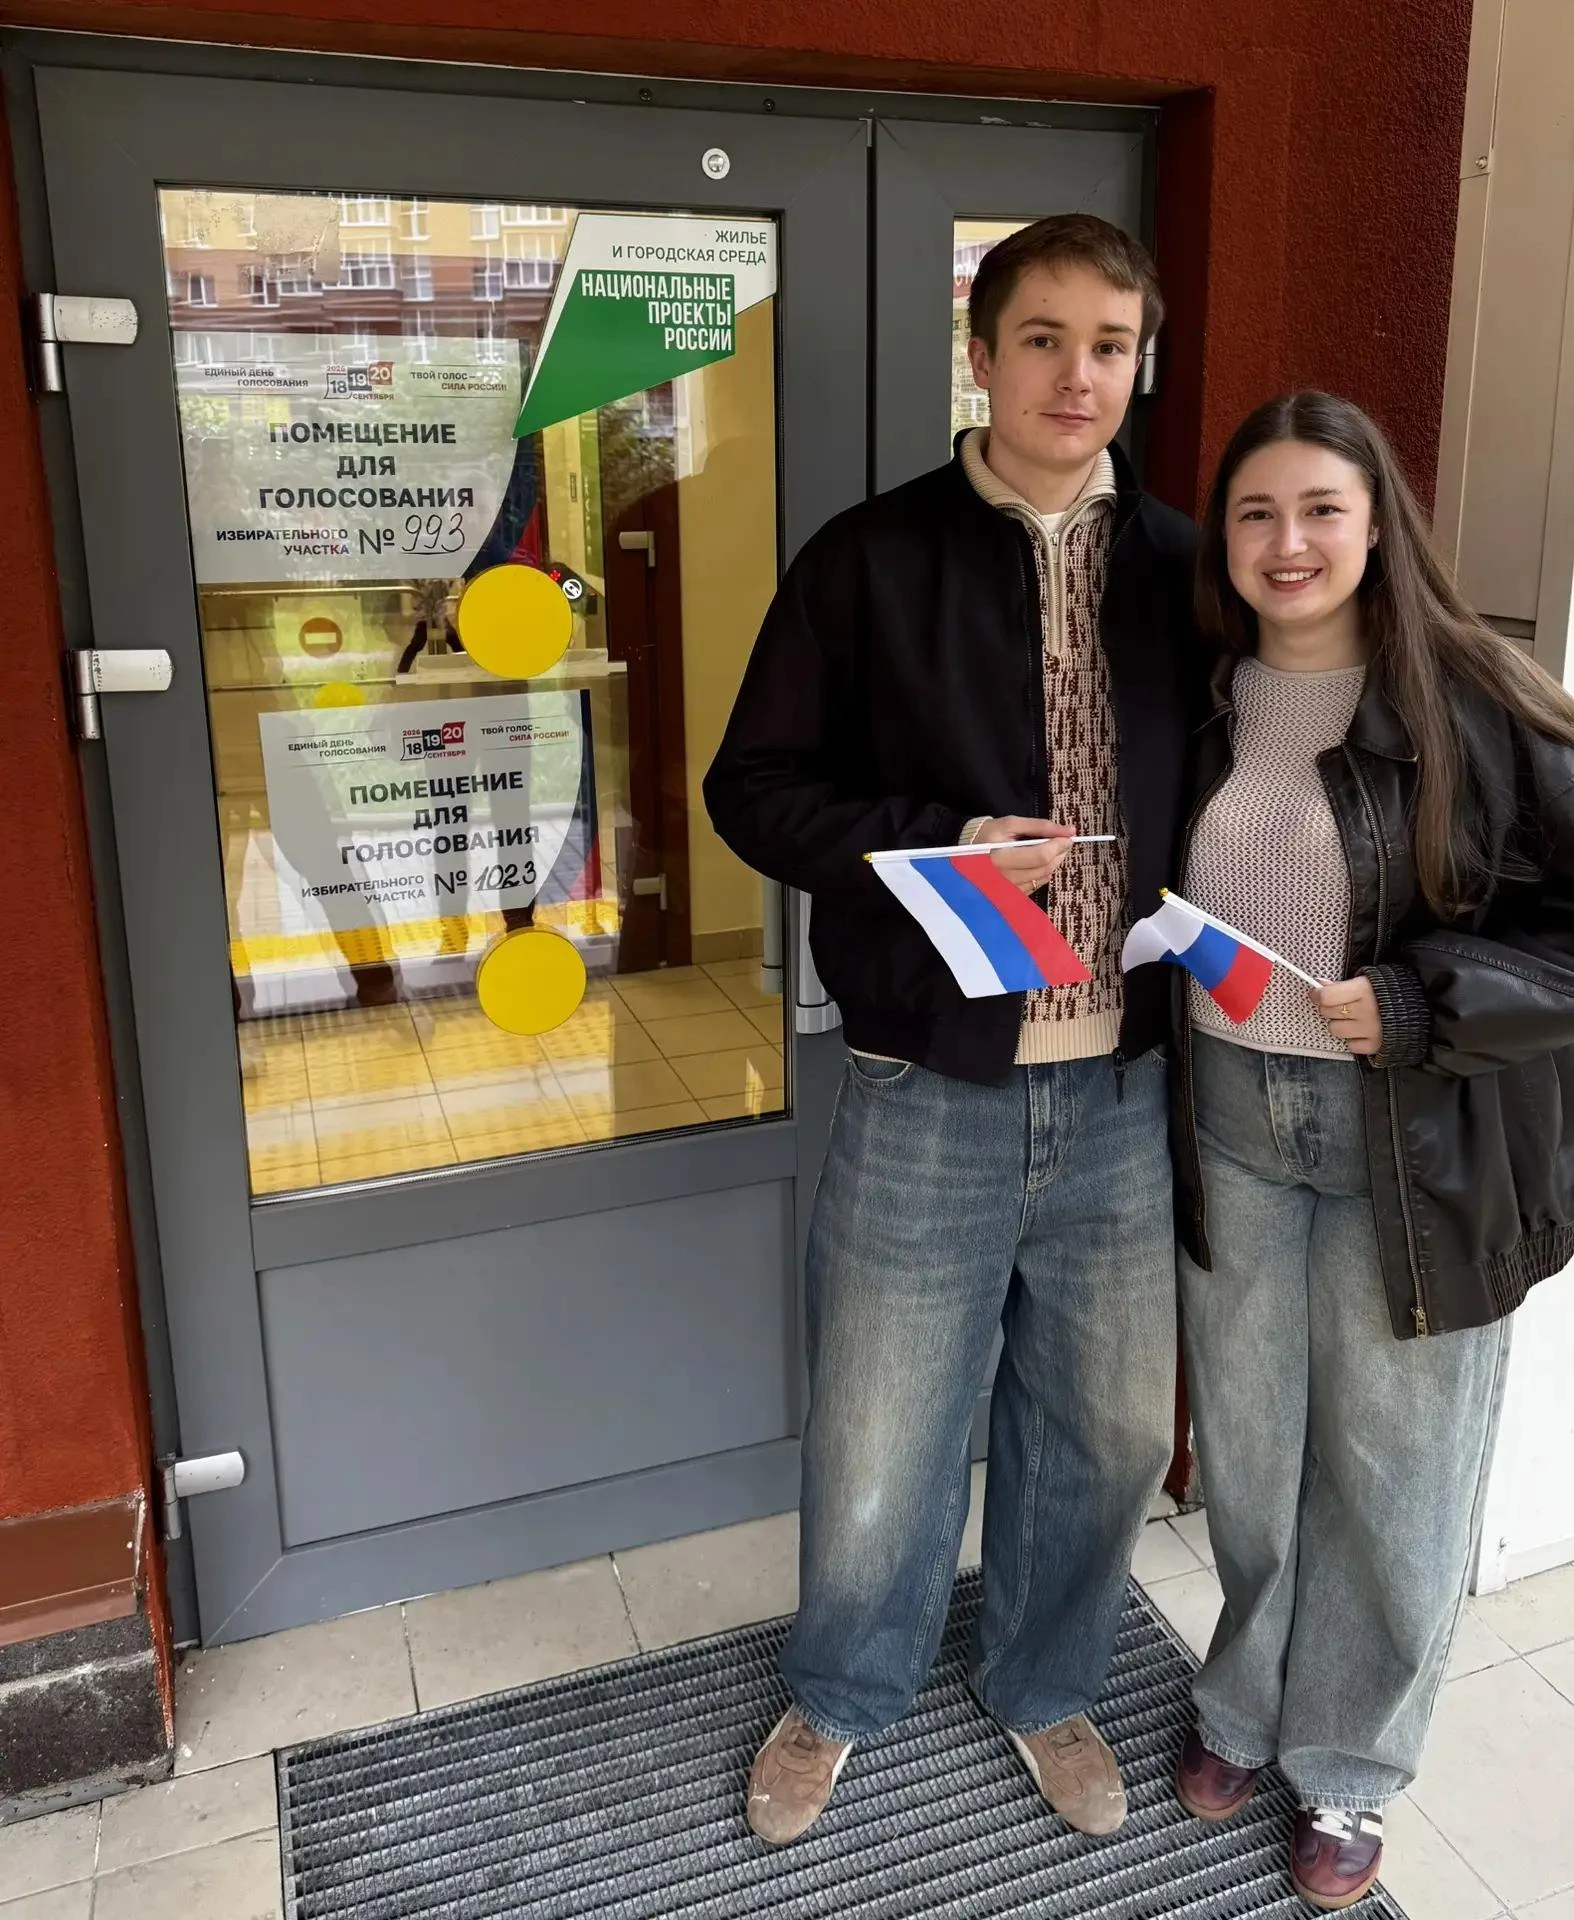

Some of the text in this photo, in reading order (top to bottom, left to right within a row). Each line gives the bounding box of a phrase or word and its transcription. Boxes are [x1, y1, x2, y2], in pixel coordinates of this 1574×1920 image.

[715, 229, 768, 245] ЖИЛЬЕ
[612, 245, 767, 265] И ГОРОДСКАЯ СРЕДА
[581, 272, 732, 301] НАЦИОНАЛЬНЫЕ
[648, 301, 732, 326] ПРОЕКТЫ
[664, 327, 732, 351] РОССИИ
[204, 367, 274, 377] ЕДИНЫЙ ДЕНЬ
[329, 367, 391, 394] 18 19 20
[410, 371, 436, 380] ТВОЙ
[437, 372, 468, 381] ГОЛОС
[237, 379, 309, 387] ГОЛОСОВАНИЯ
[441, 383, 466, 391] СИЛА
[269, 422, 456, 446] ПОМЕЩЕНИЕ
[336, 455, 396, 479] ДЛЯ
[258, 487, 474, 509] ГОЛОСОВАНИЯ
[216, 528, 349, 541] ИЗБИРАТЕЛЬНОГО
[401, 512, 465, 553] 993
[284, 544, 350, 556] УЧАСТКА
[481, 727, 503, 735] ТВОЙ
[506, 724, 533, 732] ГОЛОС
[509, 734, 532, 742] СИЛА
[288, 739, 354, 751] ЕДИНЫЙ ДЕНЬ
[319, 745, 387, 757] ГОЛОСОВАНИЯ
[406, 726, 462, 755] 18 19 20
[427, 750, 466, 759] СЕНТЯБРЯ
[350, 771, 523, 805] ПОМЕЩЕНИЕ
[413, 805, 468, 830] ДЛЯ
[341, 826, 540, 864] ГОЛОСОВАНИЯ
[301, 874, 425, 898] ИЗБИРАТЕЛЬНОГО
[474, 860, 537, 891] 1023
[364, 888, 426, 904] УЧАСТКА
